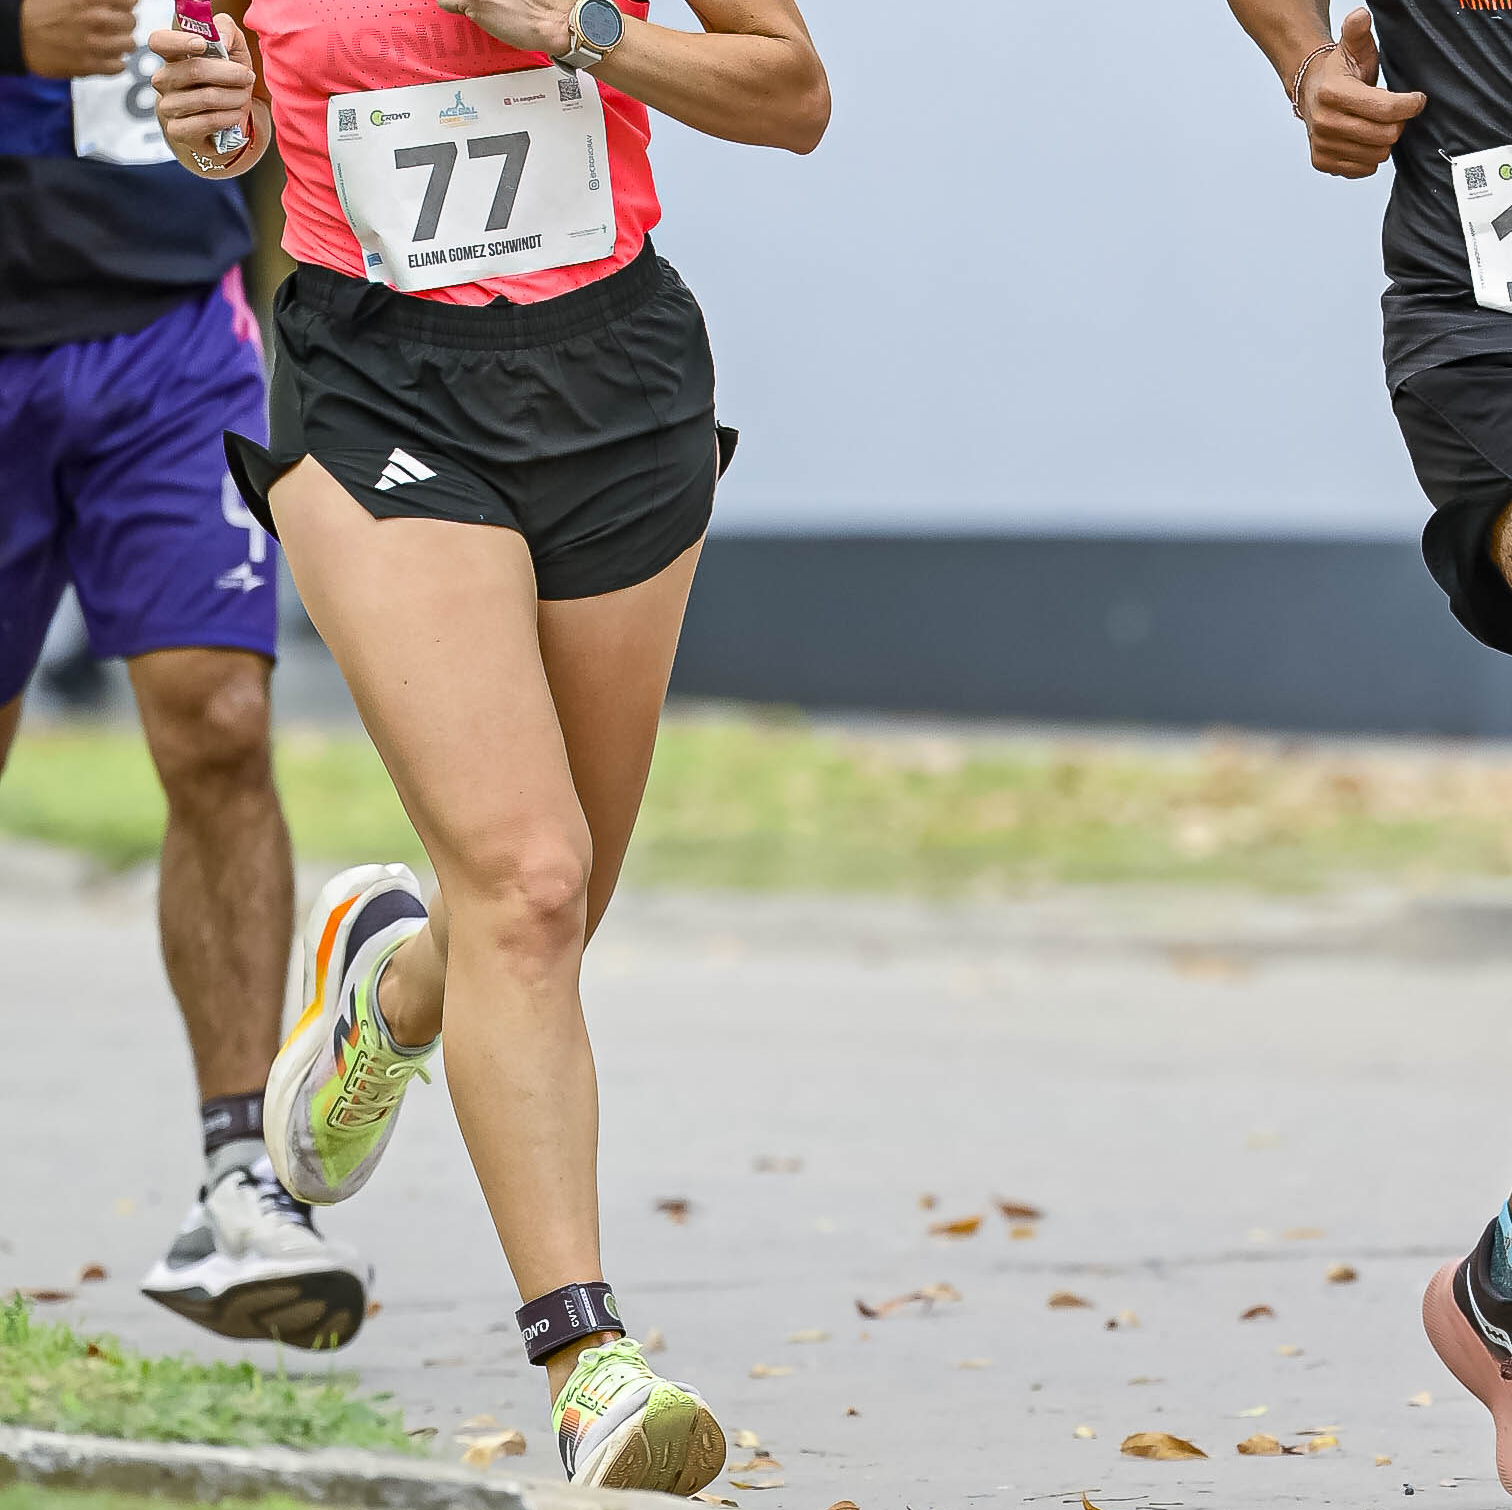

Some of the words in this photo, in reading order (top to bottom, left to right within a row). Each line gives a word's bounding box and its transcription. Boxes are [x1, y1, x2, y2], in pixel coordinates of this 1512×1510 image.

[393, 130, 531, 243] 77
[407, 249, 448, 268] ELIANA
[448, 243, 487, 263] GOMEZ
[487, 234, 543, 257] SCHWINDT
